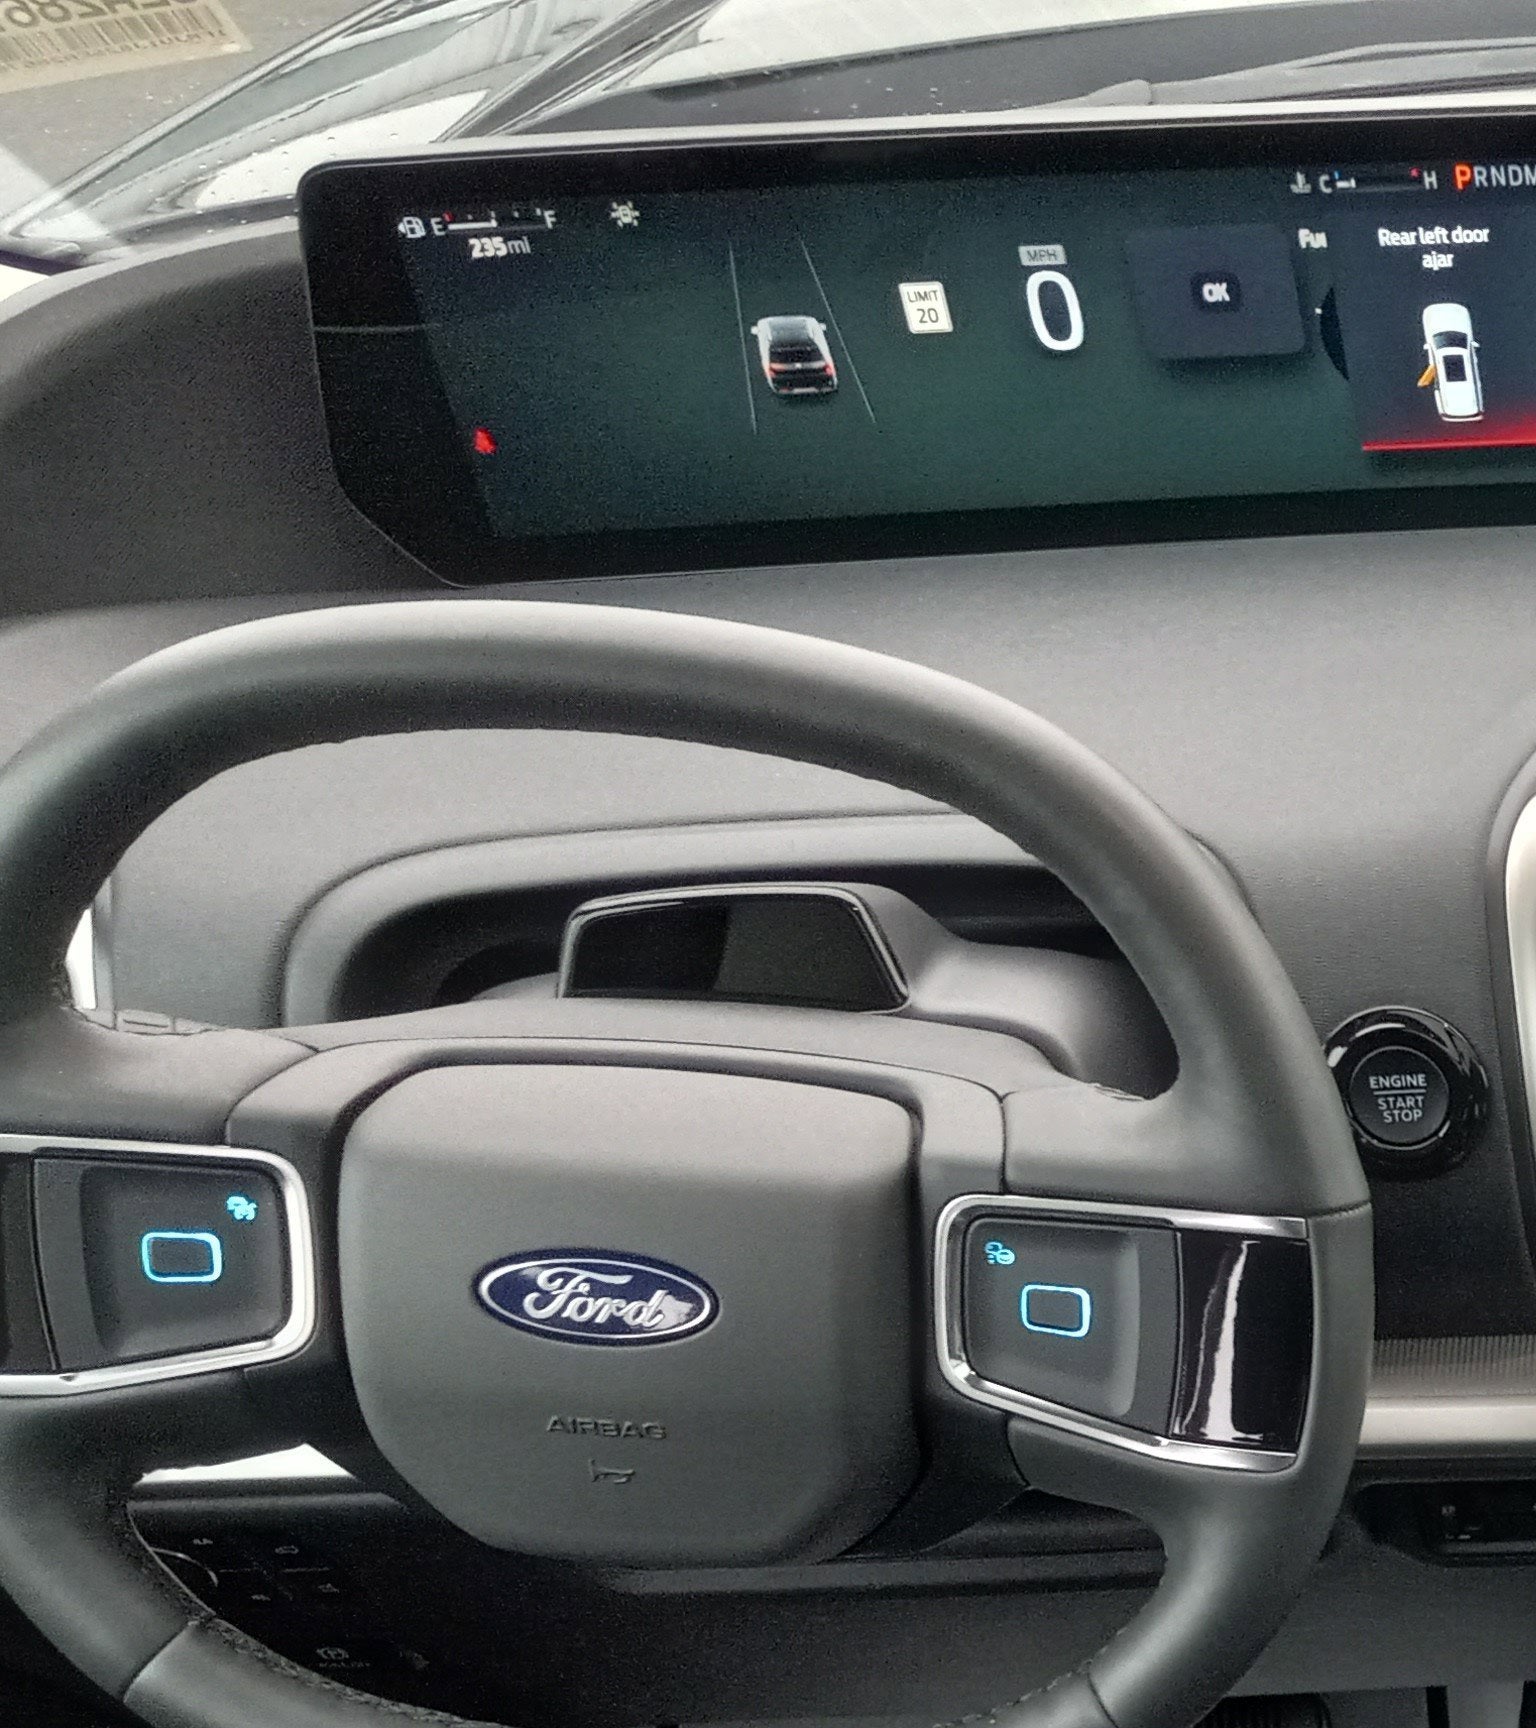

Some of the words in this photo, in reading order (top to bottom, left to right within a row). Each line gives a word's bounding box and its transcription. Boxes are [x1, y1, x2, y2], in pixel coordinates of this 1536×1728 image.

[1319, 175, 1333, 193] C
[1423, 170, 1438, 190] H
[430, 217, 447, 236] E
[543, 210, 557, 229] F
[1377, 227, 1417, 247] Rear
[1417, 226, 1449, 245] left
[1451, 225, 1490, 243] door
[468, 237, 507, 258] 235
[1422, 251, 1454, 270] ajar
[907, 289, 939, 303] LIMIT
[1202, 282, 1231, 303] OK
[917, 308, 940, 324] 20
[1026, 270, 1085, 352] 0
[1369, 1073, 1427, 1089] ENGINE
[1378, 1096, 1424, 1110] START
[1383, 1109, 1422, 1123] STOP
[523, 1267, 668, 1328] Ford
[546, 1416, 666, 1440] AIRBAG
